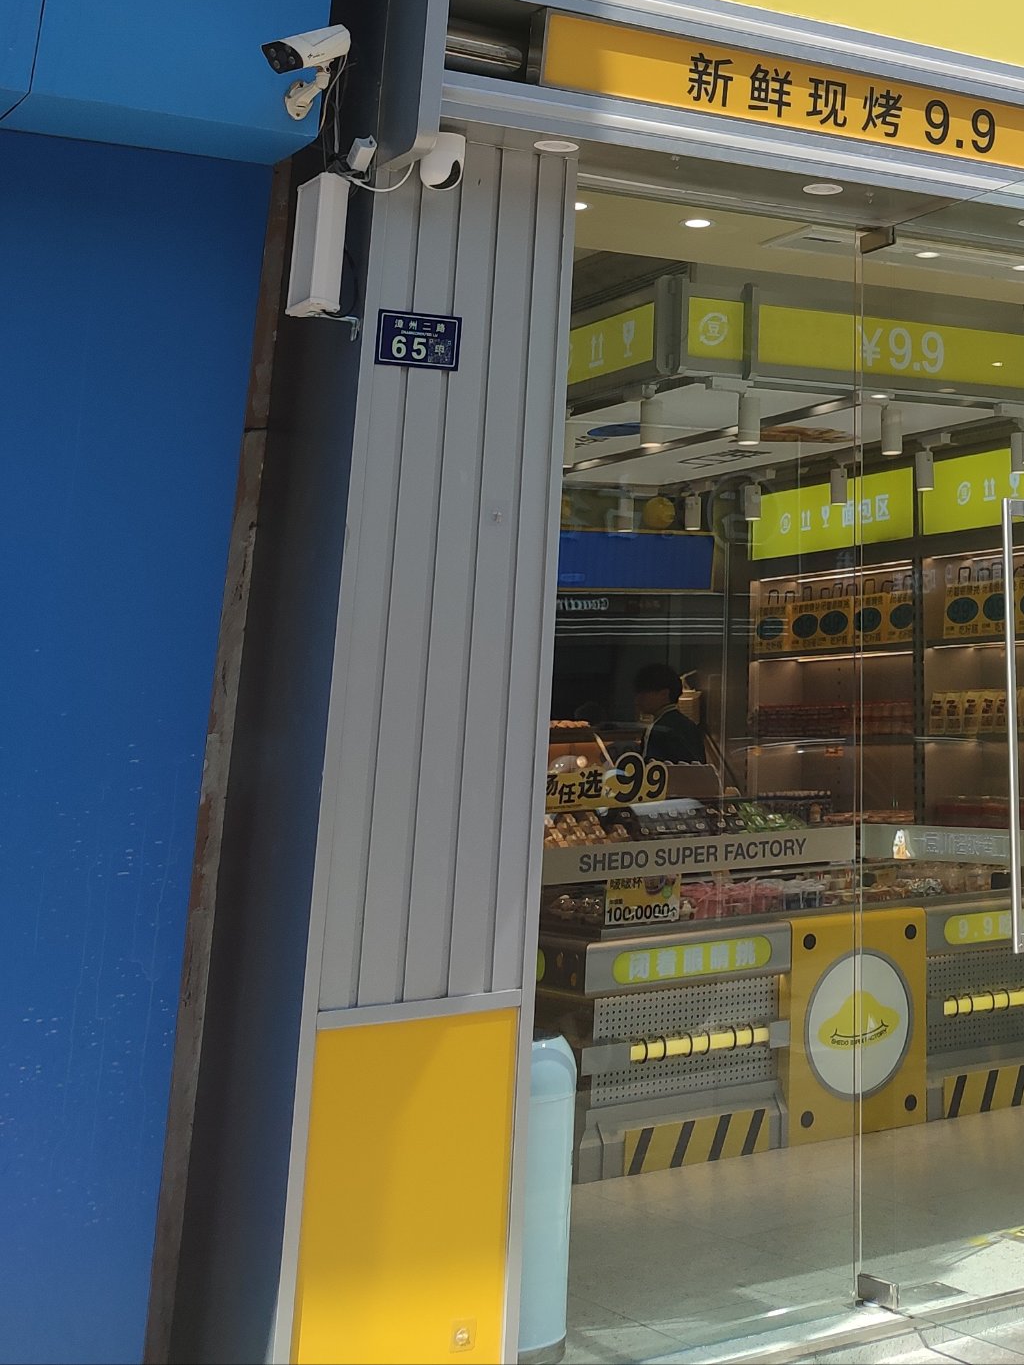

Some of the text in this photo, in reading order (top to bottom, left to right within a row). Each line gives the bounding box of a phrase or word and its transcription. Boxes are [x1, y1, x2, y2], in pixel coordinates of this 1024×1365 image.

[686, 53, 997, 154] 新鲜现烤 9.9
[391, 335, 428, 360] 65
[860, 324, 945, 374] ¥9.9
[579, 837, 807, 874] SHEDO SUPER FACTORY
